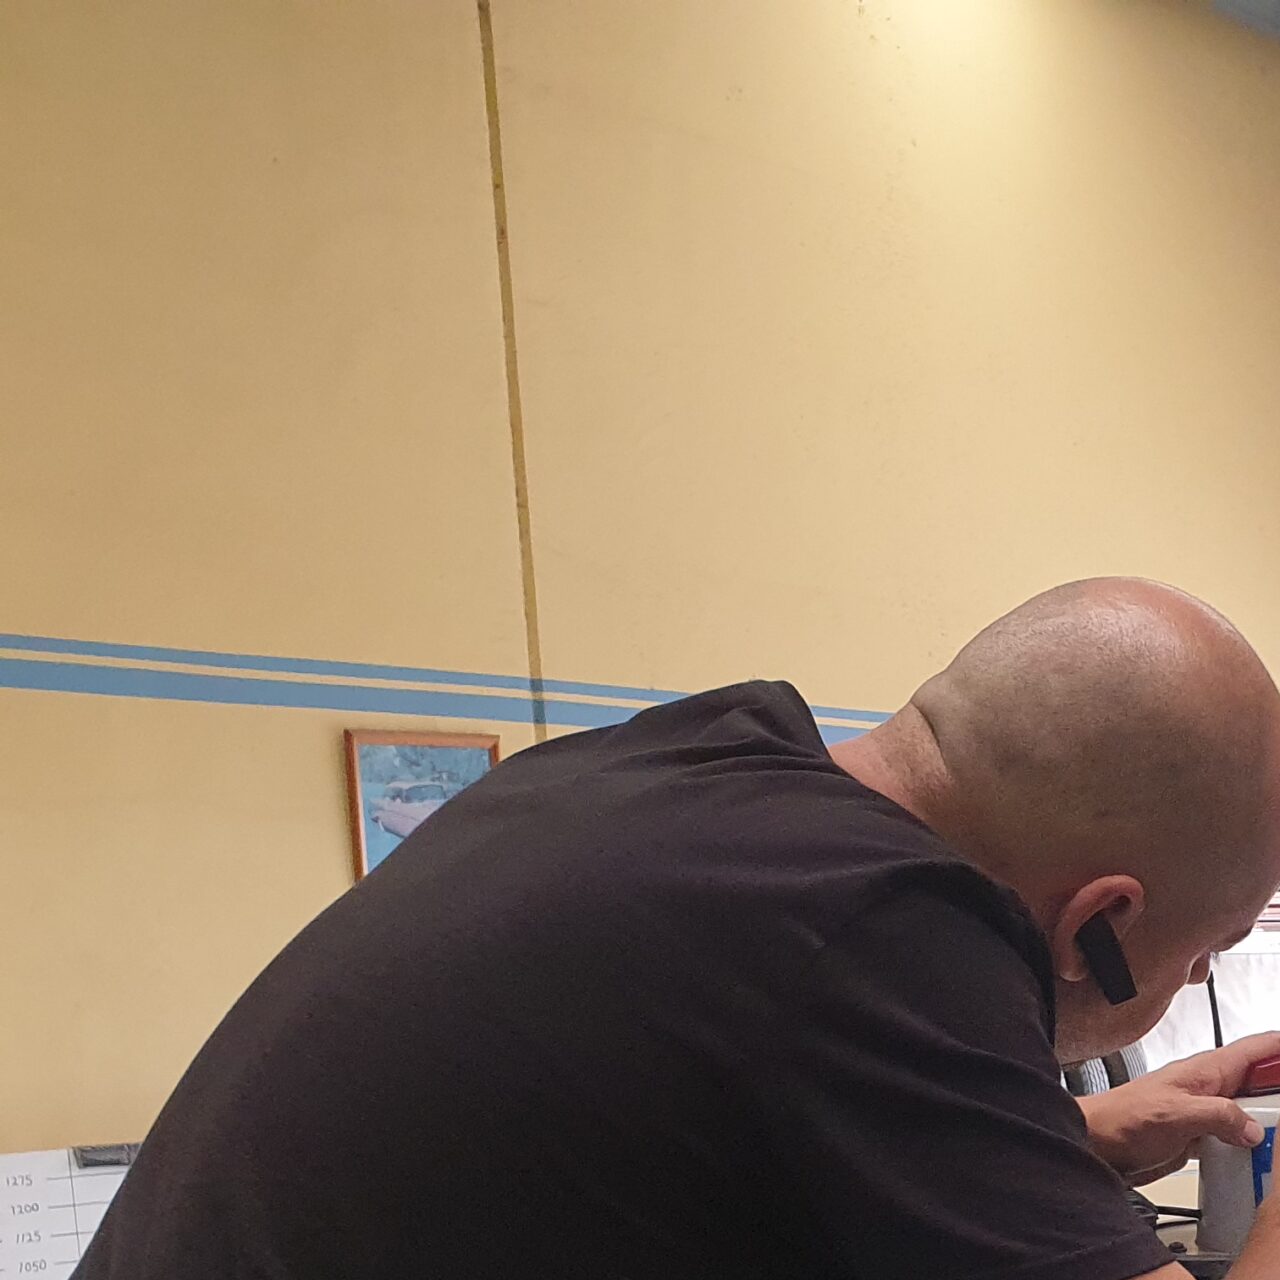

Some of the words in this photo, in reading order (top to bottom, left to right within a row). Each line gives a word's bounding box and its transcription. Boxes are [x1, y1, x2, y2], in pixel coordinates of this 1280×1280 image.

[6, 1174, 33, 1187] 1275
[11, 1202, 40, 1216] 1200
[16, 1230, 41, 1244] 1125
[19, 1259, 47, 1273] 1050
